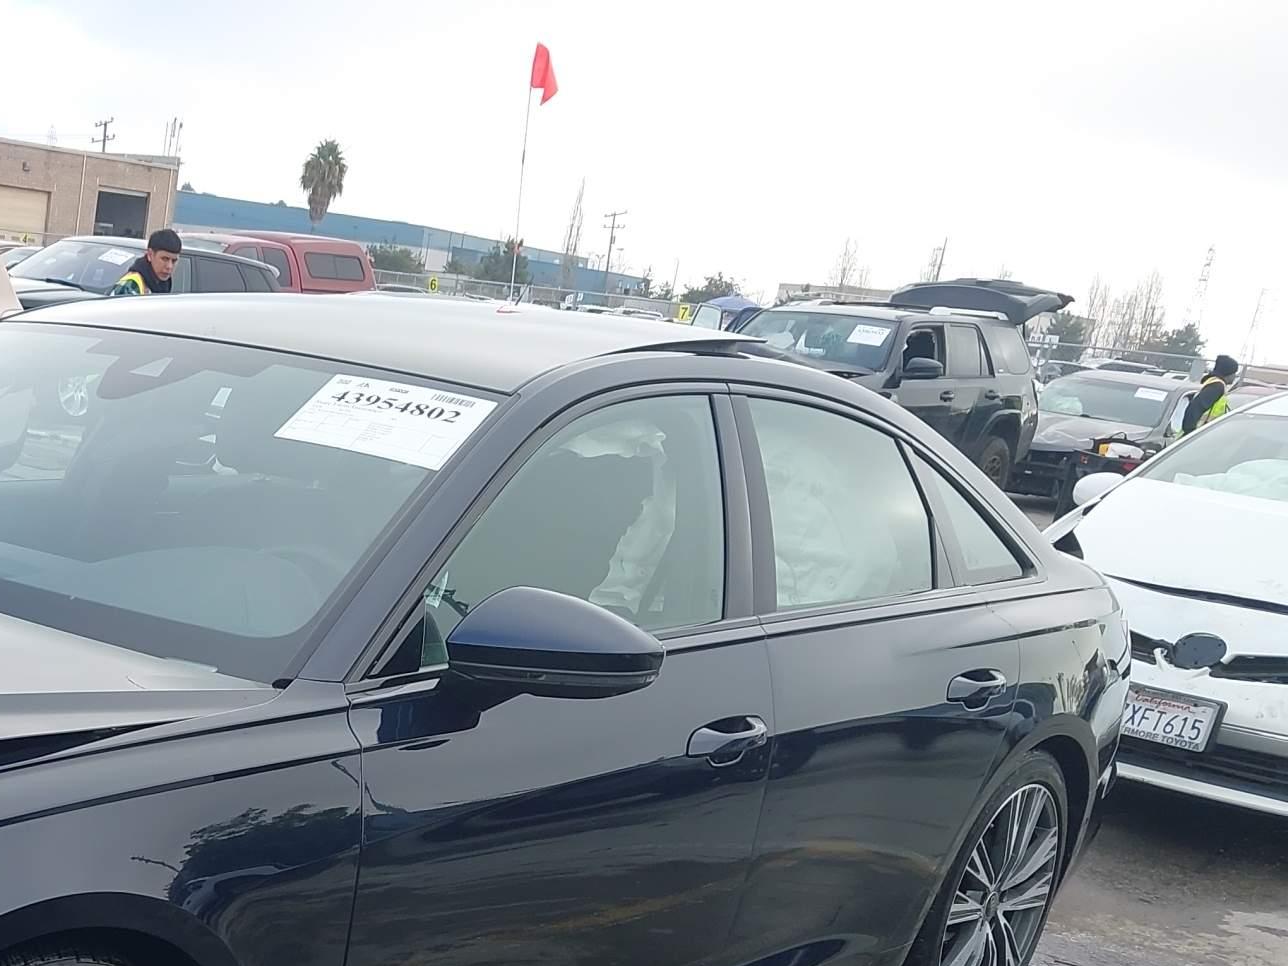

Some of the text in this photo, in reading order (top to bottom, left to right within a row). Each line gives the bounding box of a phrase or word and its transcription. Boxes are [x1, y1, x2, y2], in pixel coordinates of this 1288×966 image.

[430, 278, 437, 291] 6
[681, 306, 689, 320] 7
[331, 389, 462, 424] 43954802
[1134, 692, 1196, 714] California
[1122, 725, 1201, 751] RMORE TOYOTA
